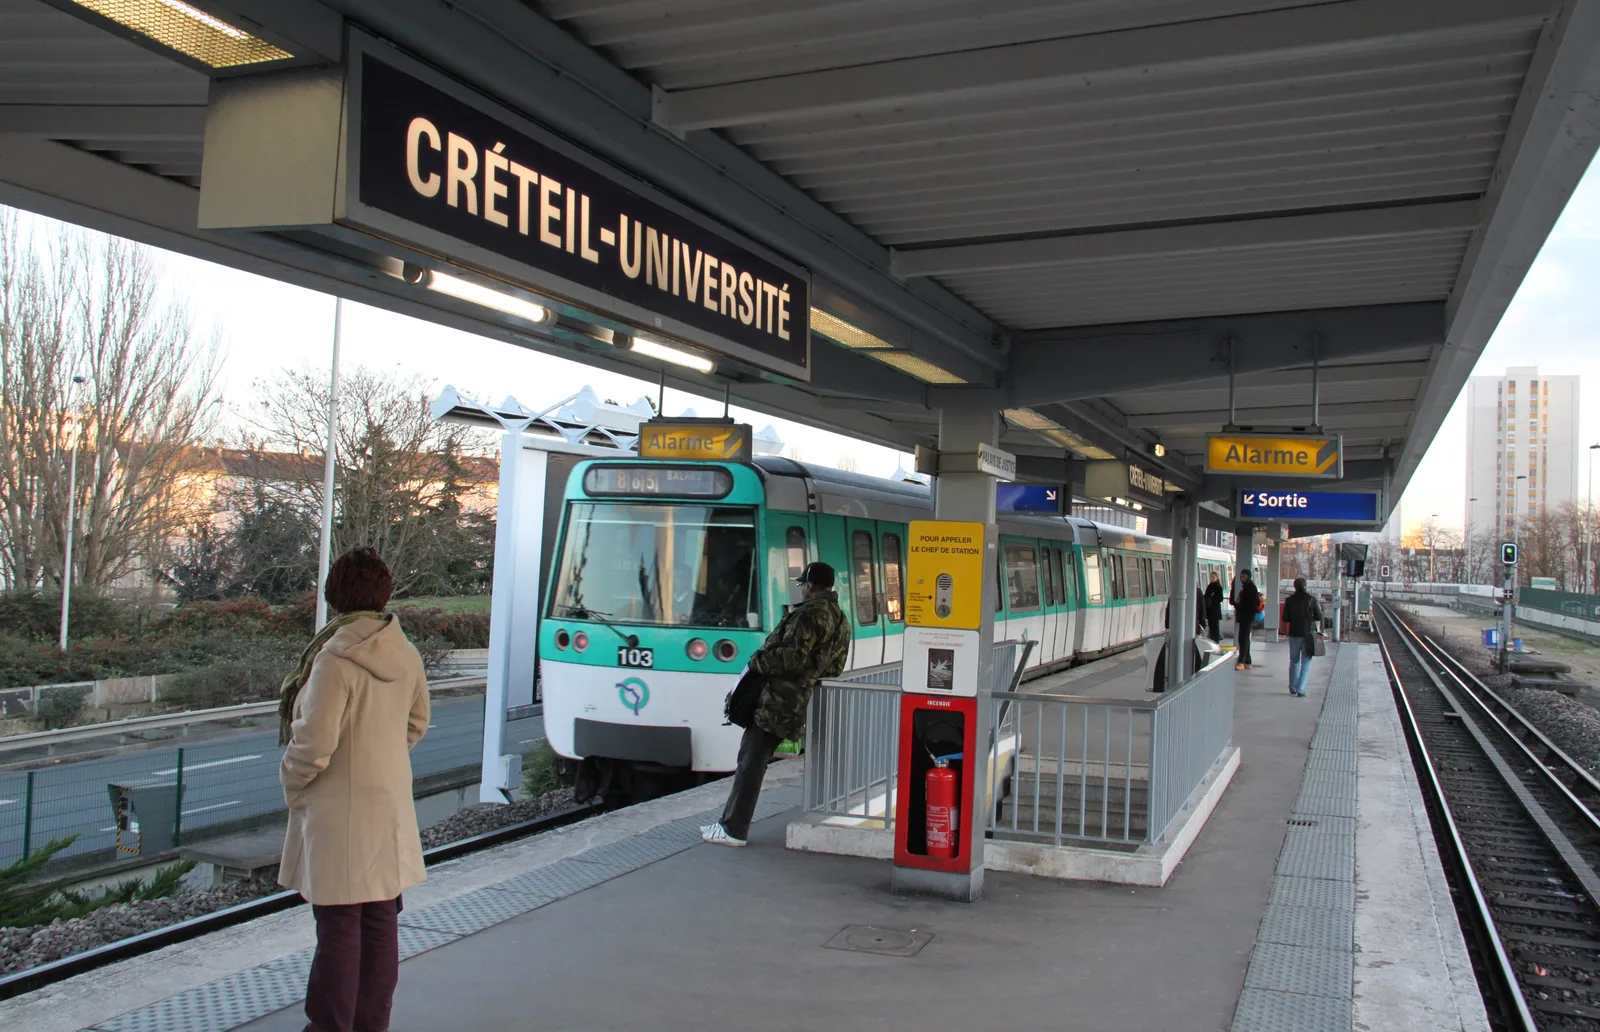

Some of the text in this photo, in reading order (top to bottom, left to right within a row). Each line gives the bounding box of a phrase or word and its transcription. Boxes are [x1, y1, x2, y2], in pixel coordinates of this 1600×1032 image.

[405, 117, 791, 341] CRÉTEIL-UNIVERSITÉ
[649, 434, 714, 451] Alarme
[1224, 444, 1309, 465] Alarme
[1258, 493, 1308, 508] Sortie
[951, 547, 980, 555] STATION
[618, 649, 653, 667] 103
